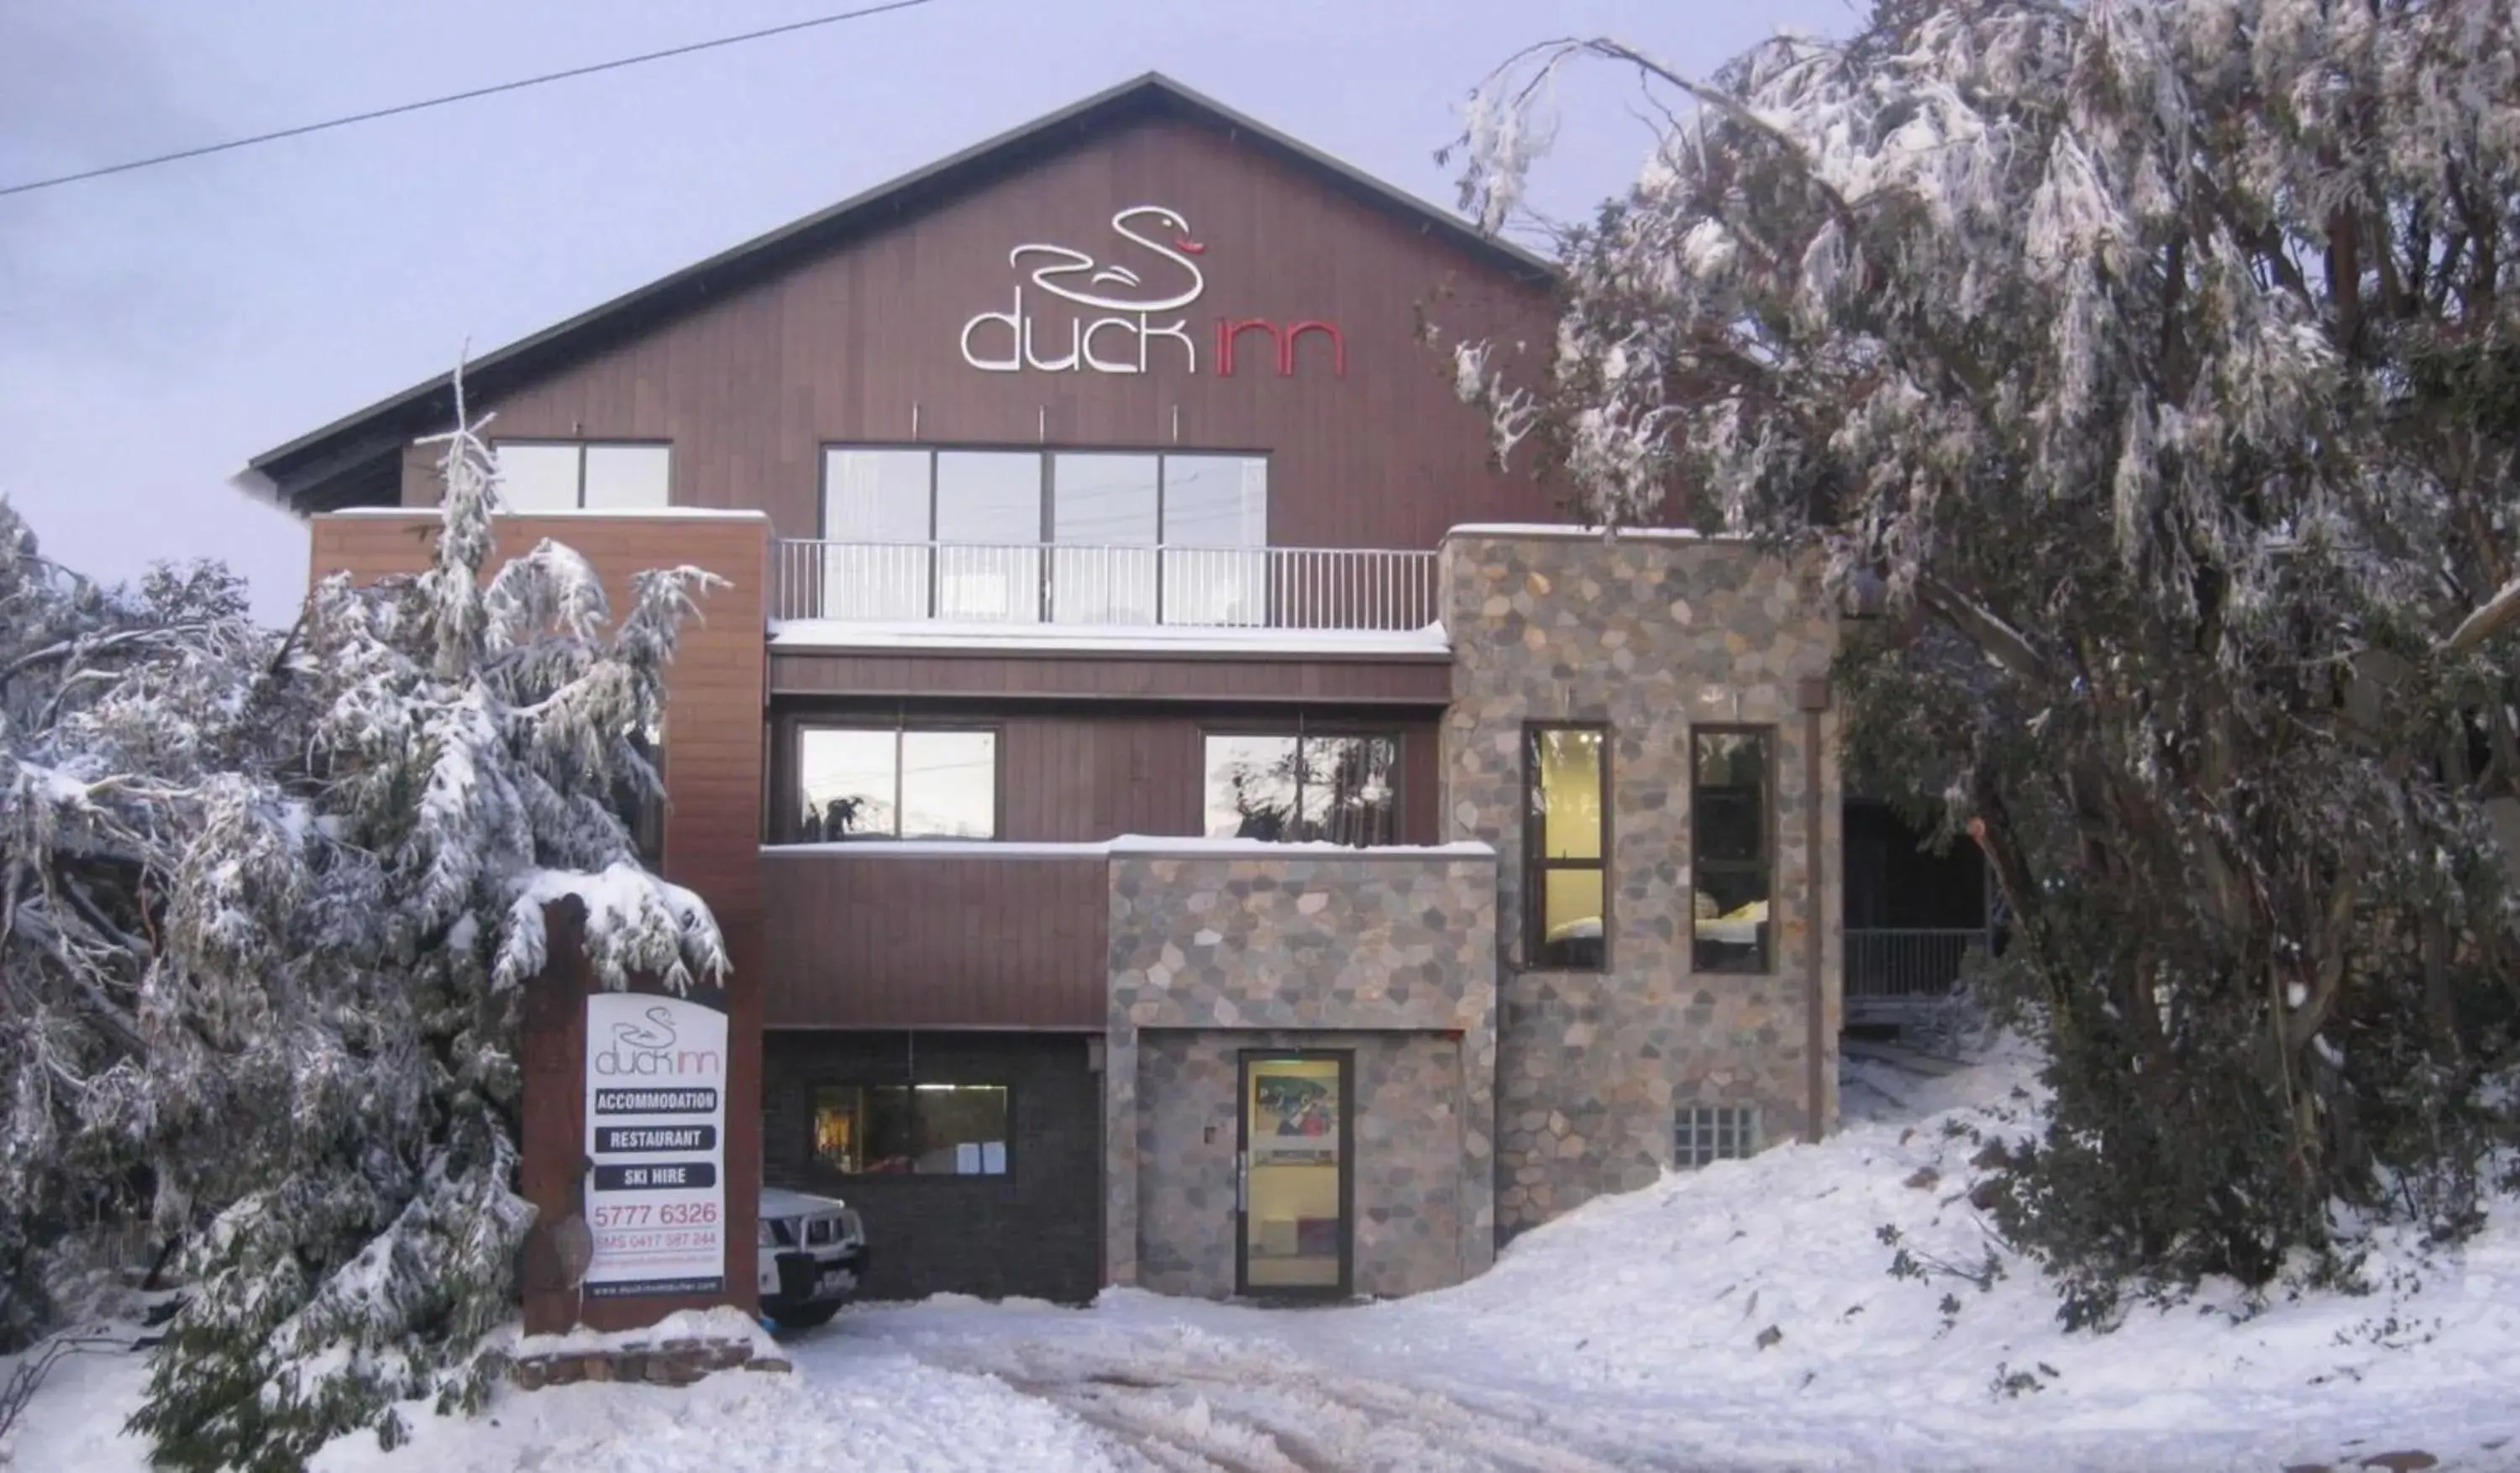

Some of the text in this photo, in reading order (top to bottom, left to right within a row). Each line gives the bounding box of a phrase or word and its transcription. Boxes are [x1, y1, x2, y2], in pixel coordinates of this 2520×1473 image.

[960, 285, 1346, 377] duck inn
[594, 1038, 720, 1076] duck inn
[597, 1092, 714, 1110] ACCOMMODATION
[610, 1129, 701, 1149] RESTAURANT
[624, 1167, 686, 1185] SKI HIRE
[595, 1202, 717, 1228] 5777 6326
[595, 1233, 627, 1250] SMS
